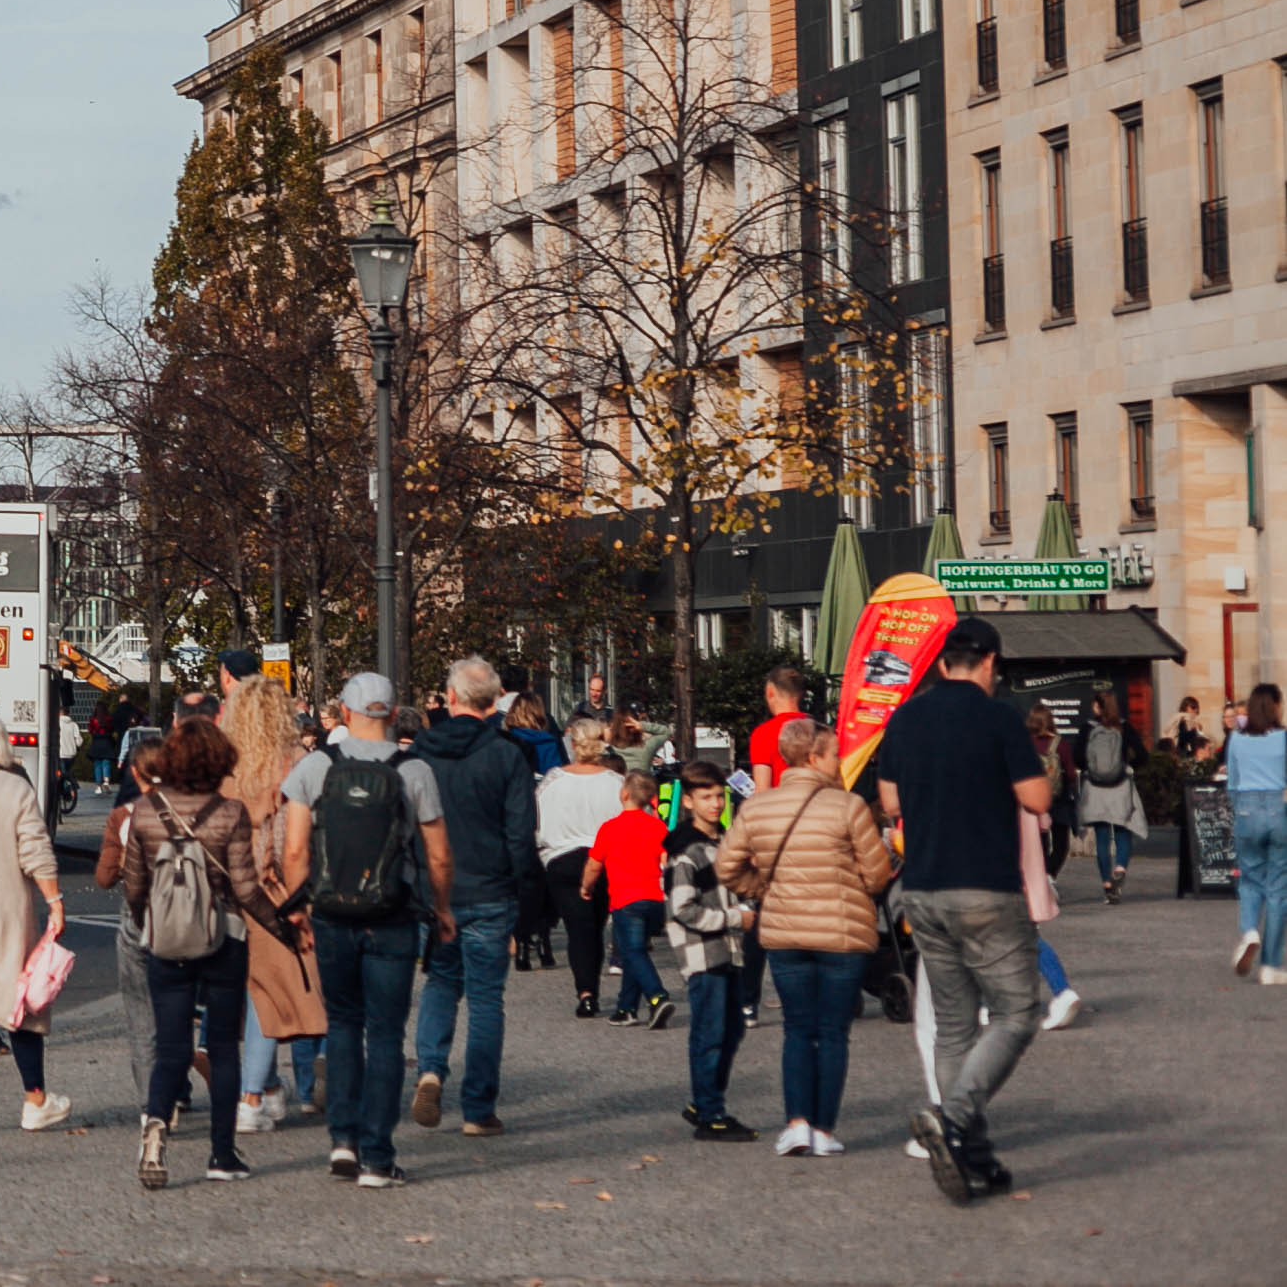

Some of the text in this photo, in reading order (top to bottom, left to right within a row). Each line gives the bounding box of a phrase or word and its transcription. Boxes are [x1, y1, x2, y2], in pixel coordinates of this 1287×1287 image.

[940, 562, 1105, 577] HOPFINGERBRÄU TO GO
[1012, 578, 1052, 589] Drinks
[1058, 578, 1070, 589] &
[1073, 577, 1106, 588] More
[893, 608, 939, 623] HOP ON
[880, 619, 931, 634] HOP OFF
